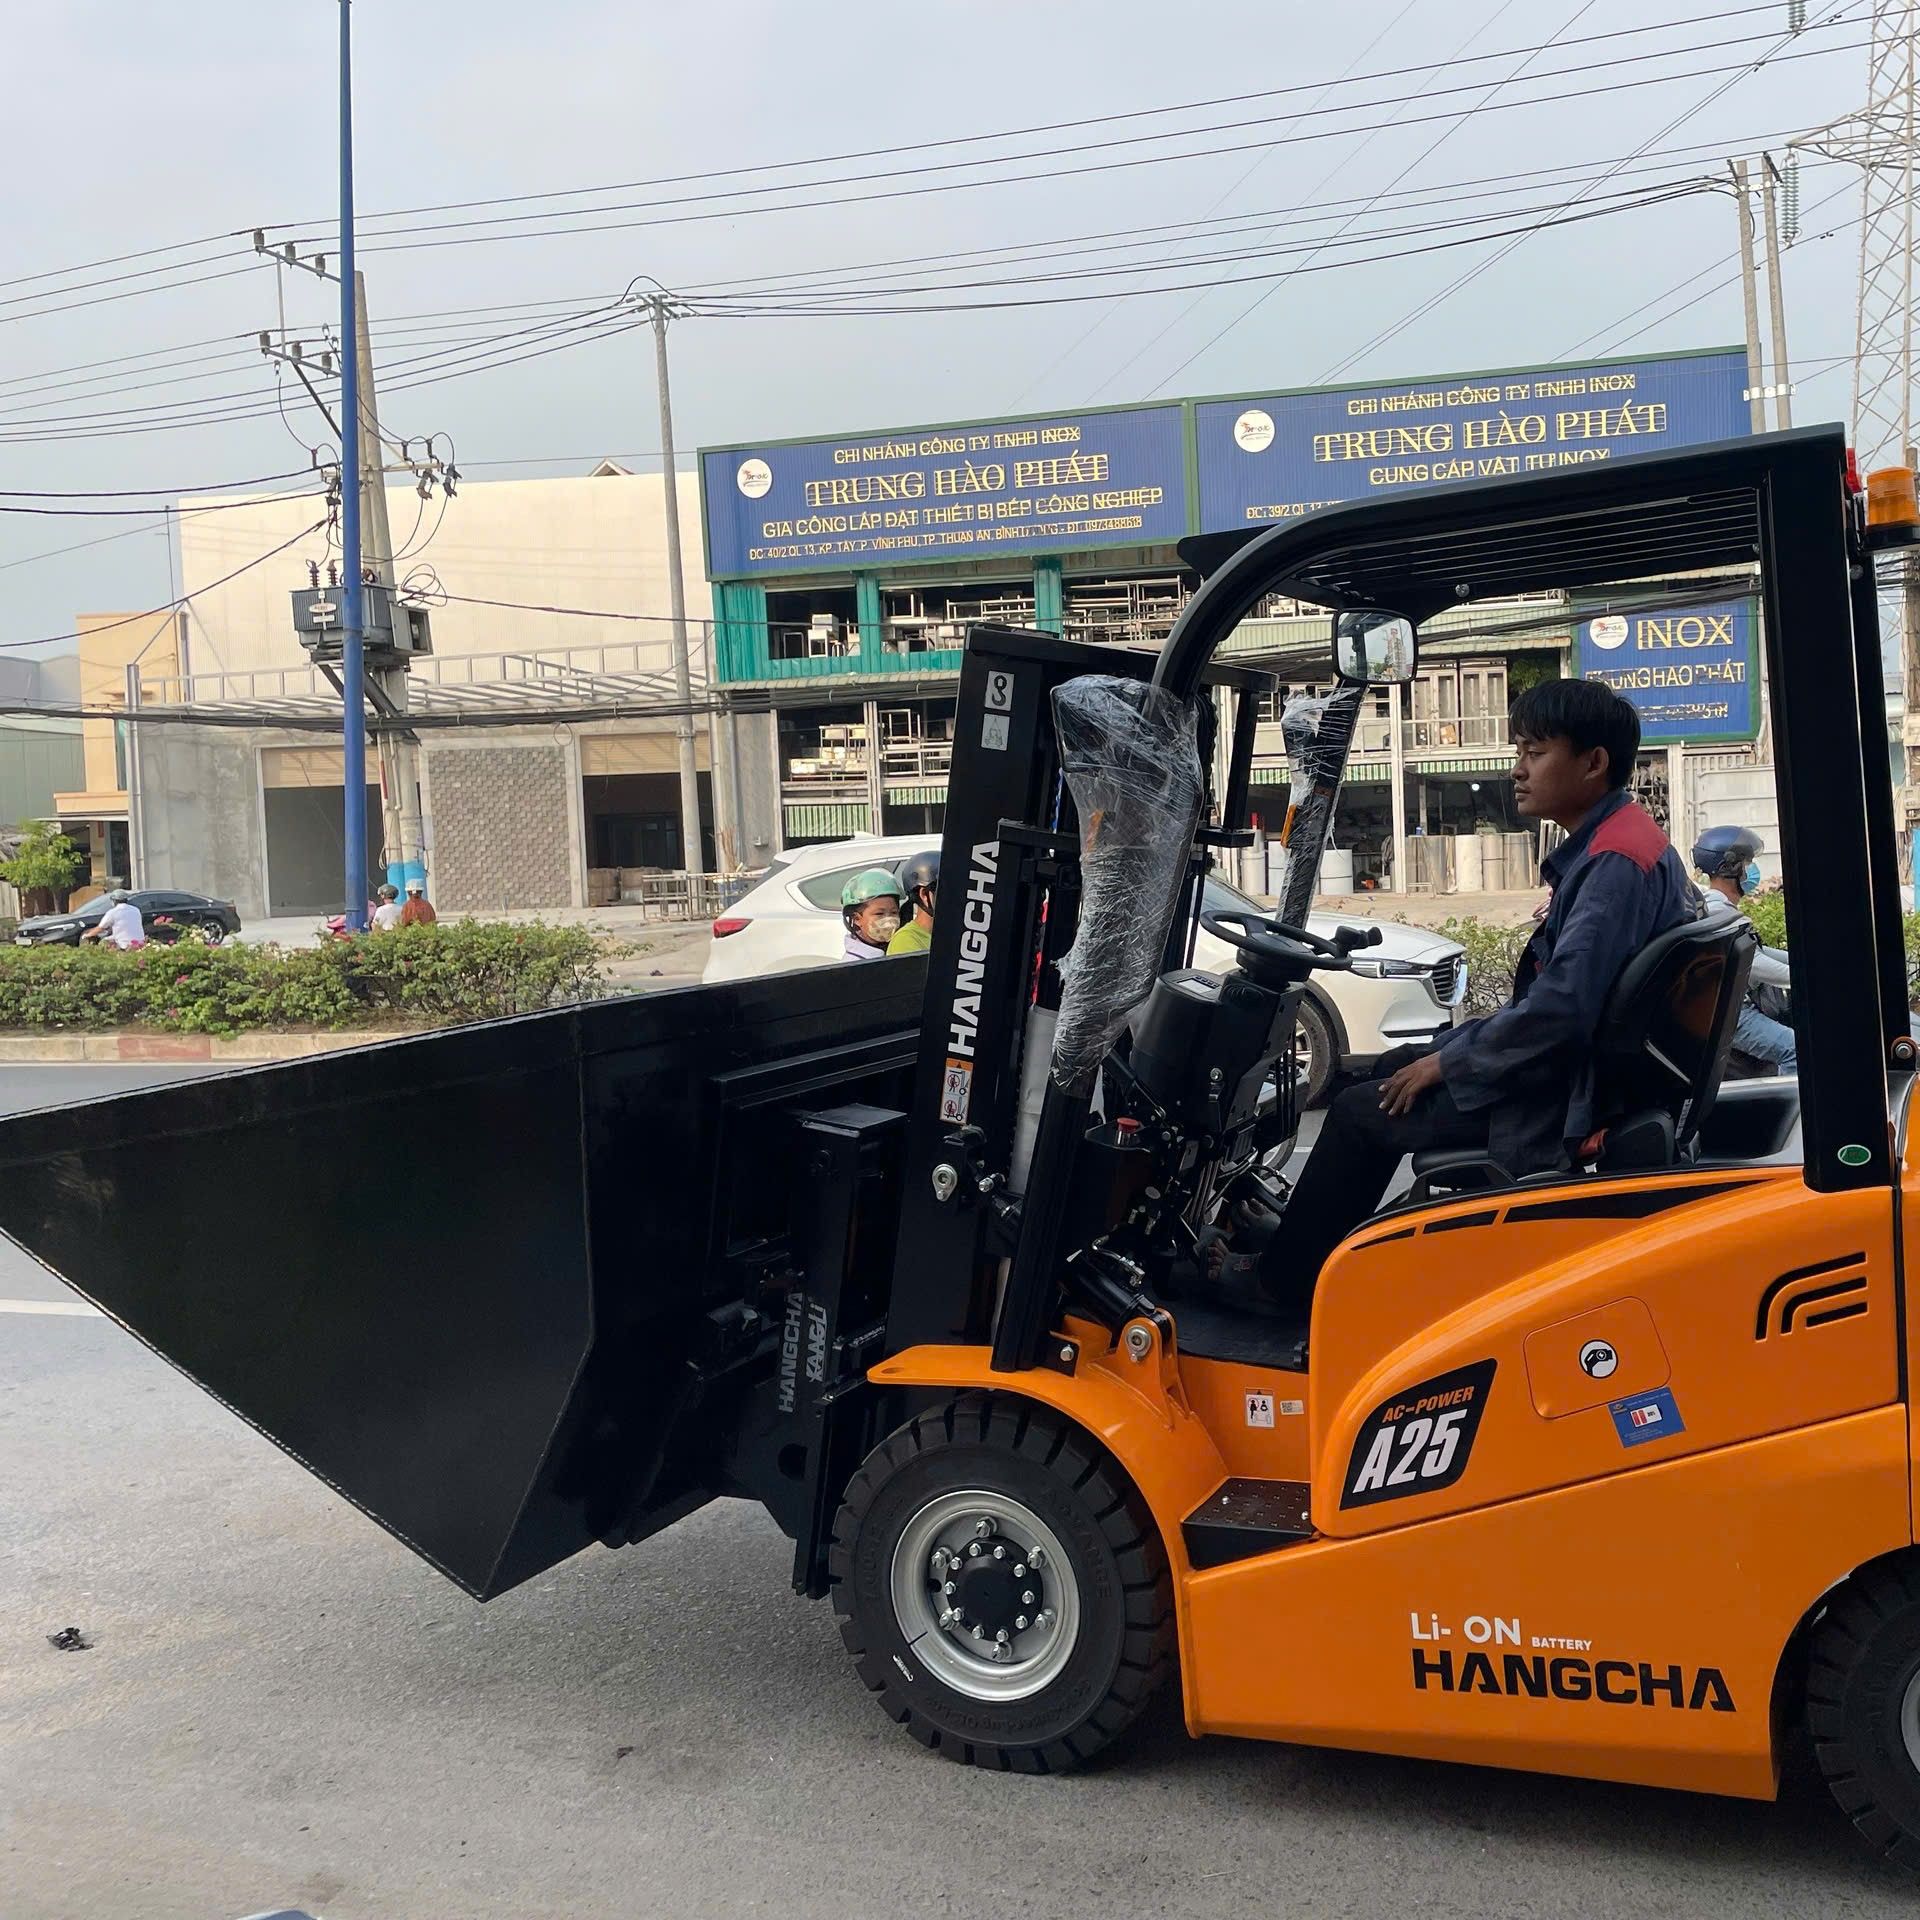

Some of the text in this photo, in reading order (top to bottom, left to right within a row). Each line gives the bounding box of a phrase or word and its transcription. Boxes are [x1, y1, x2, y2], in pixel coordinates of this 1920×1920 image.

[1348, 373, 1636, 415] CHI NHÁNH CÔNG TY TNHH INOX
[835, 426, 1081, 464] CHI NHÁNH CÔNG TY TNHH INOX
[1314, 398, 1666, 462] TRUNG HÀO PHÁT
[806, 449, 1109, 507] TRUNG HÀO PHÁT
[1370, 464, 1428, 485] CUNG
[763, 520, 793, 538] GIA
[796, 515, 847, 536] CÔNG
[978, 503, 993, 521] BỊ
[1036, 494, 1089, 514] CÔNG
[1637, 615, 1734, 651] INOX
[948, 841, 1000, 1057] HANGCHA
[778, 1292, 803, 1413] HANGCHA
[1382, 1386, 1475, 1423] AC-POWER
[1353, 1408, 1468, 1493] A25
[1410, 1612, 1592, 1651] Li- ON BATTERY
[1411, 1648, 1737, 1712] HANGCHA
